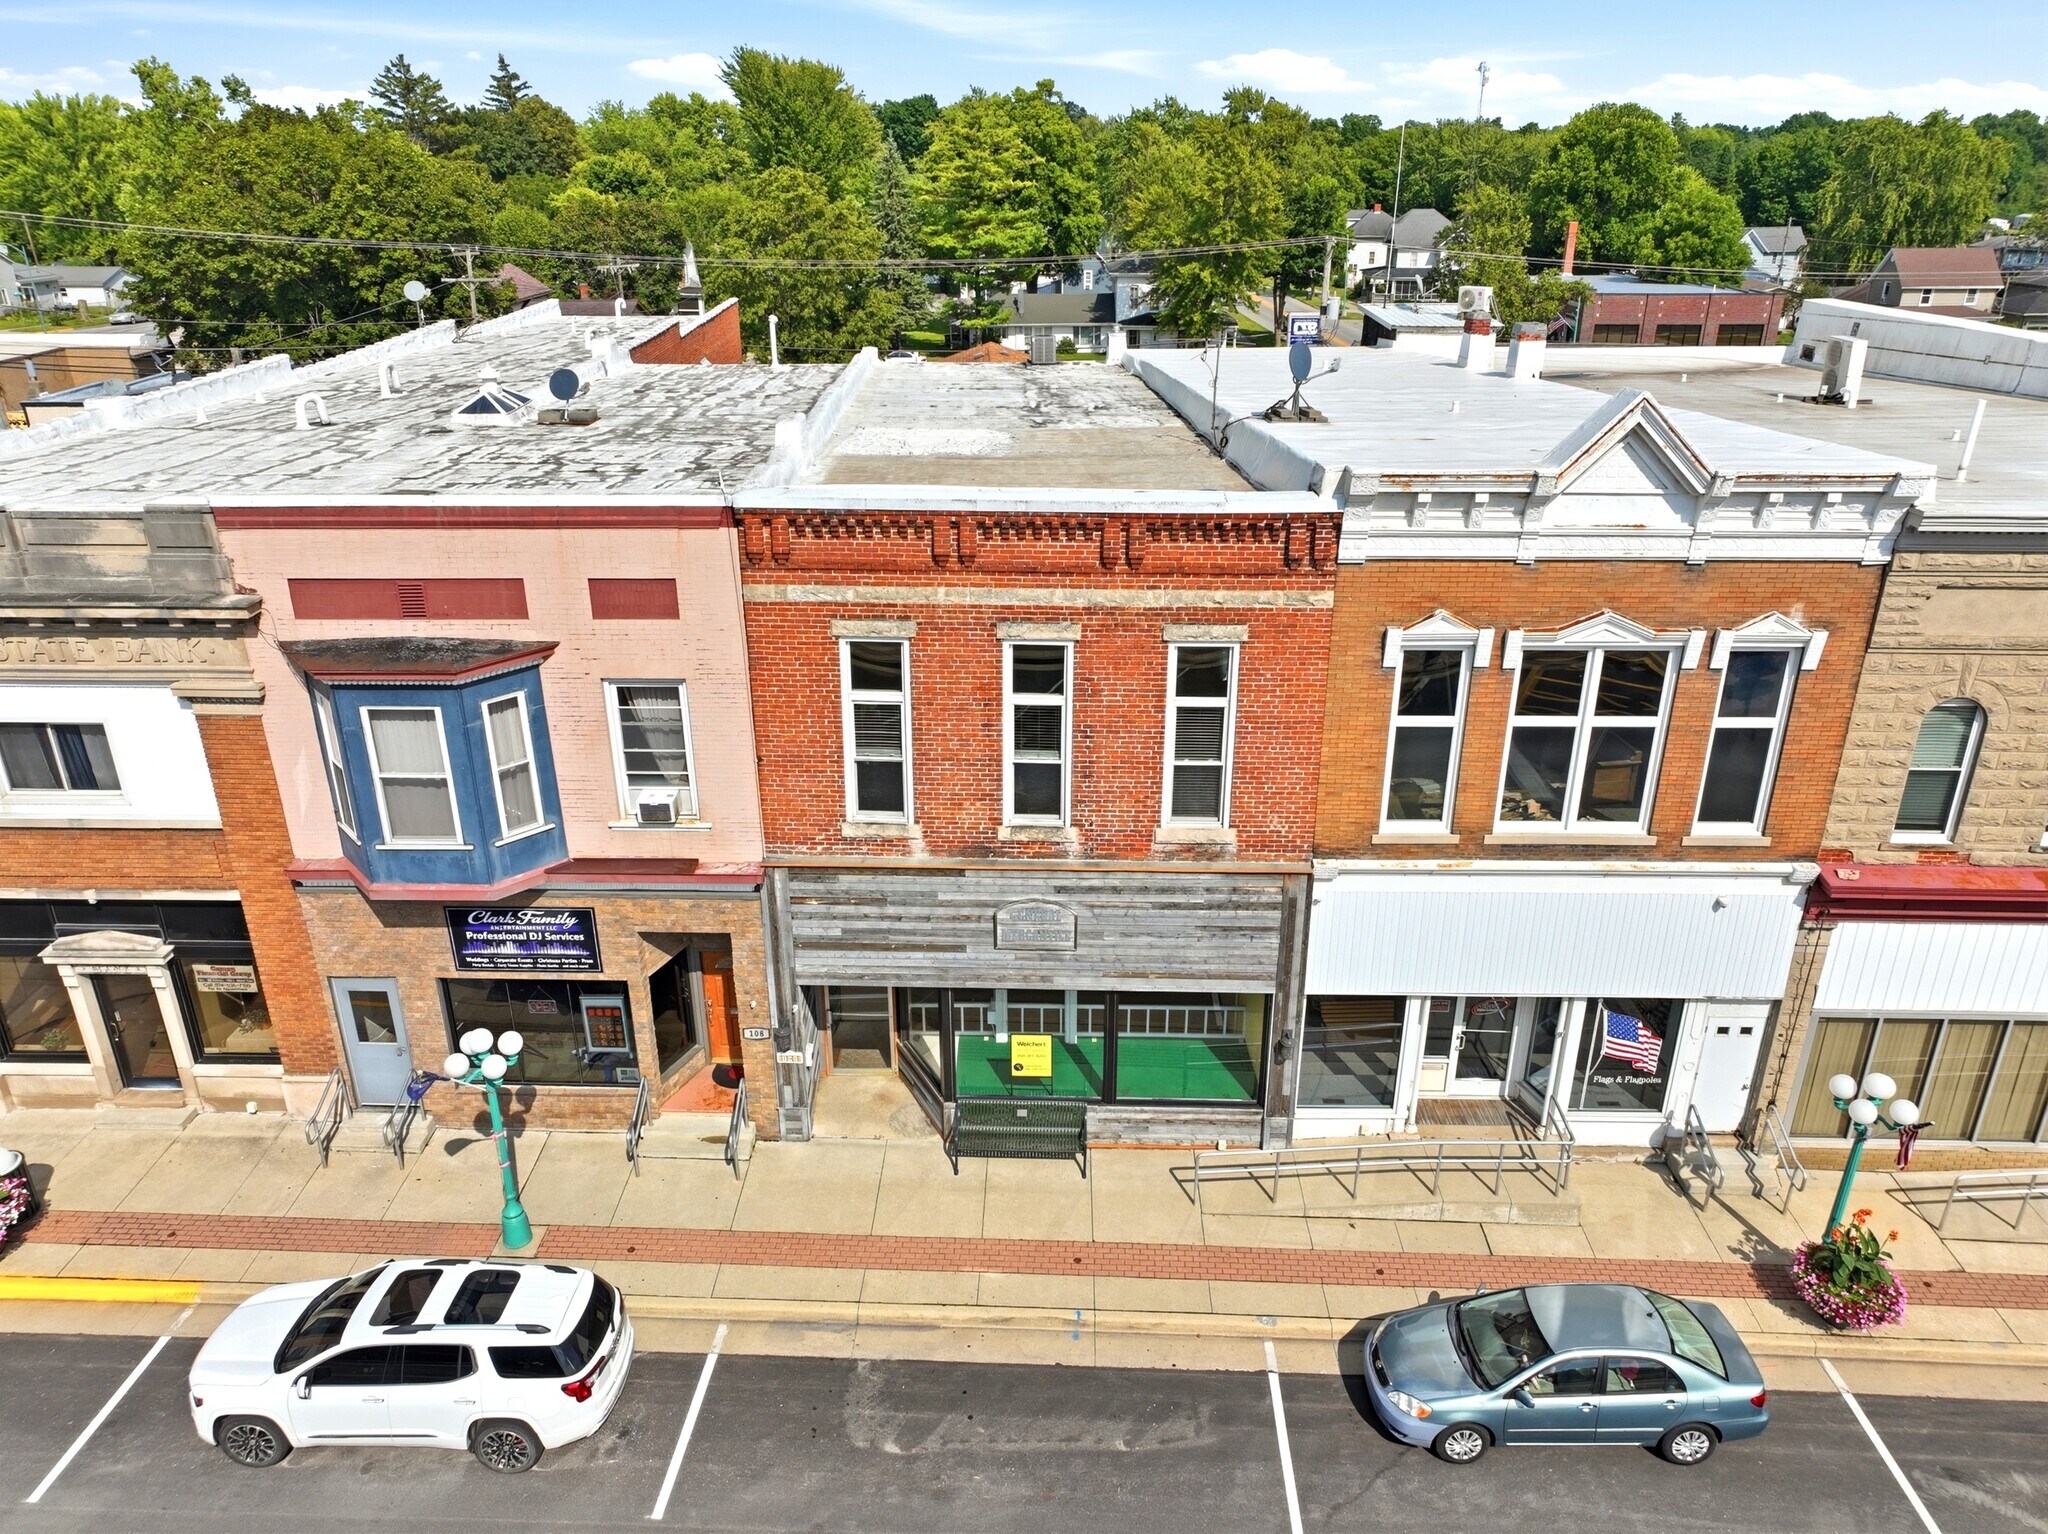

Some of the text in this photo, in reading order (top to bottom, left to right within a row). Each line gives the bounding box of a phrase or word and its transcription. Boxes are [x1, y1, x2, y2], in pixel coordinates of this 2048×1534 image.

[114, 640, 208, 663] BANK
[467, 910, 578, 929] Clark Family
[466, 932, 527, 940] Professional
[545, 933, 585, 941] Services
[530, 1002, 556, 1012] OPEN
[1593, 1075, 1615, 1085] Flags
[1624, 1075, 1662, 1085] Flagpoles
